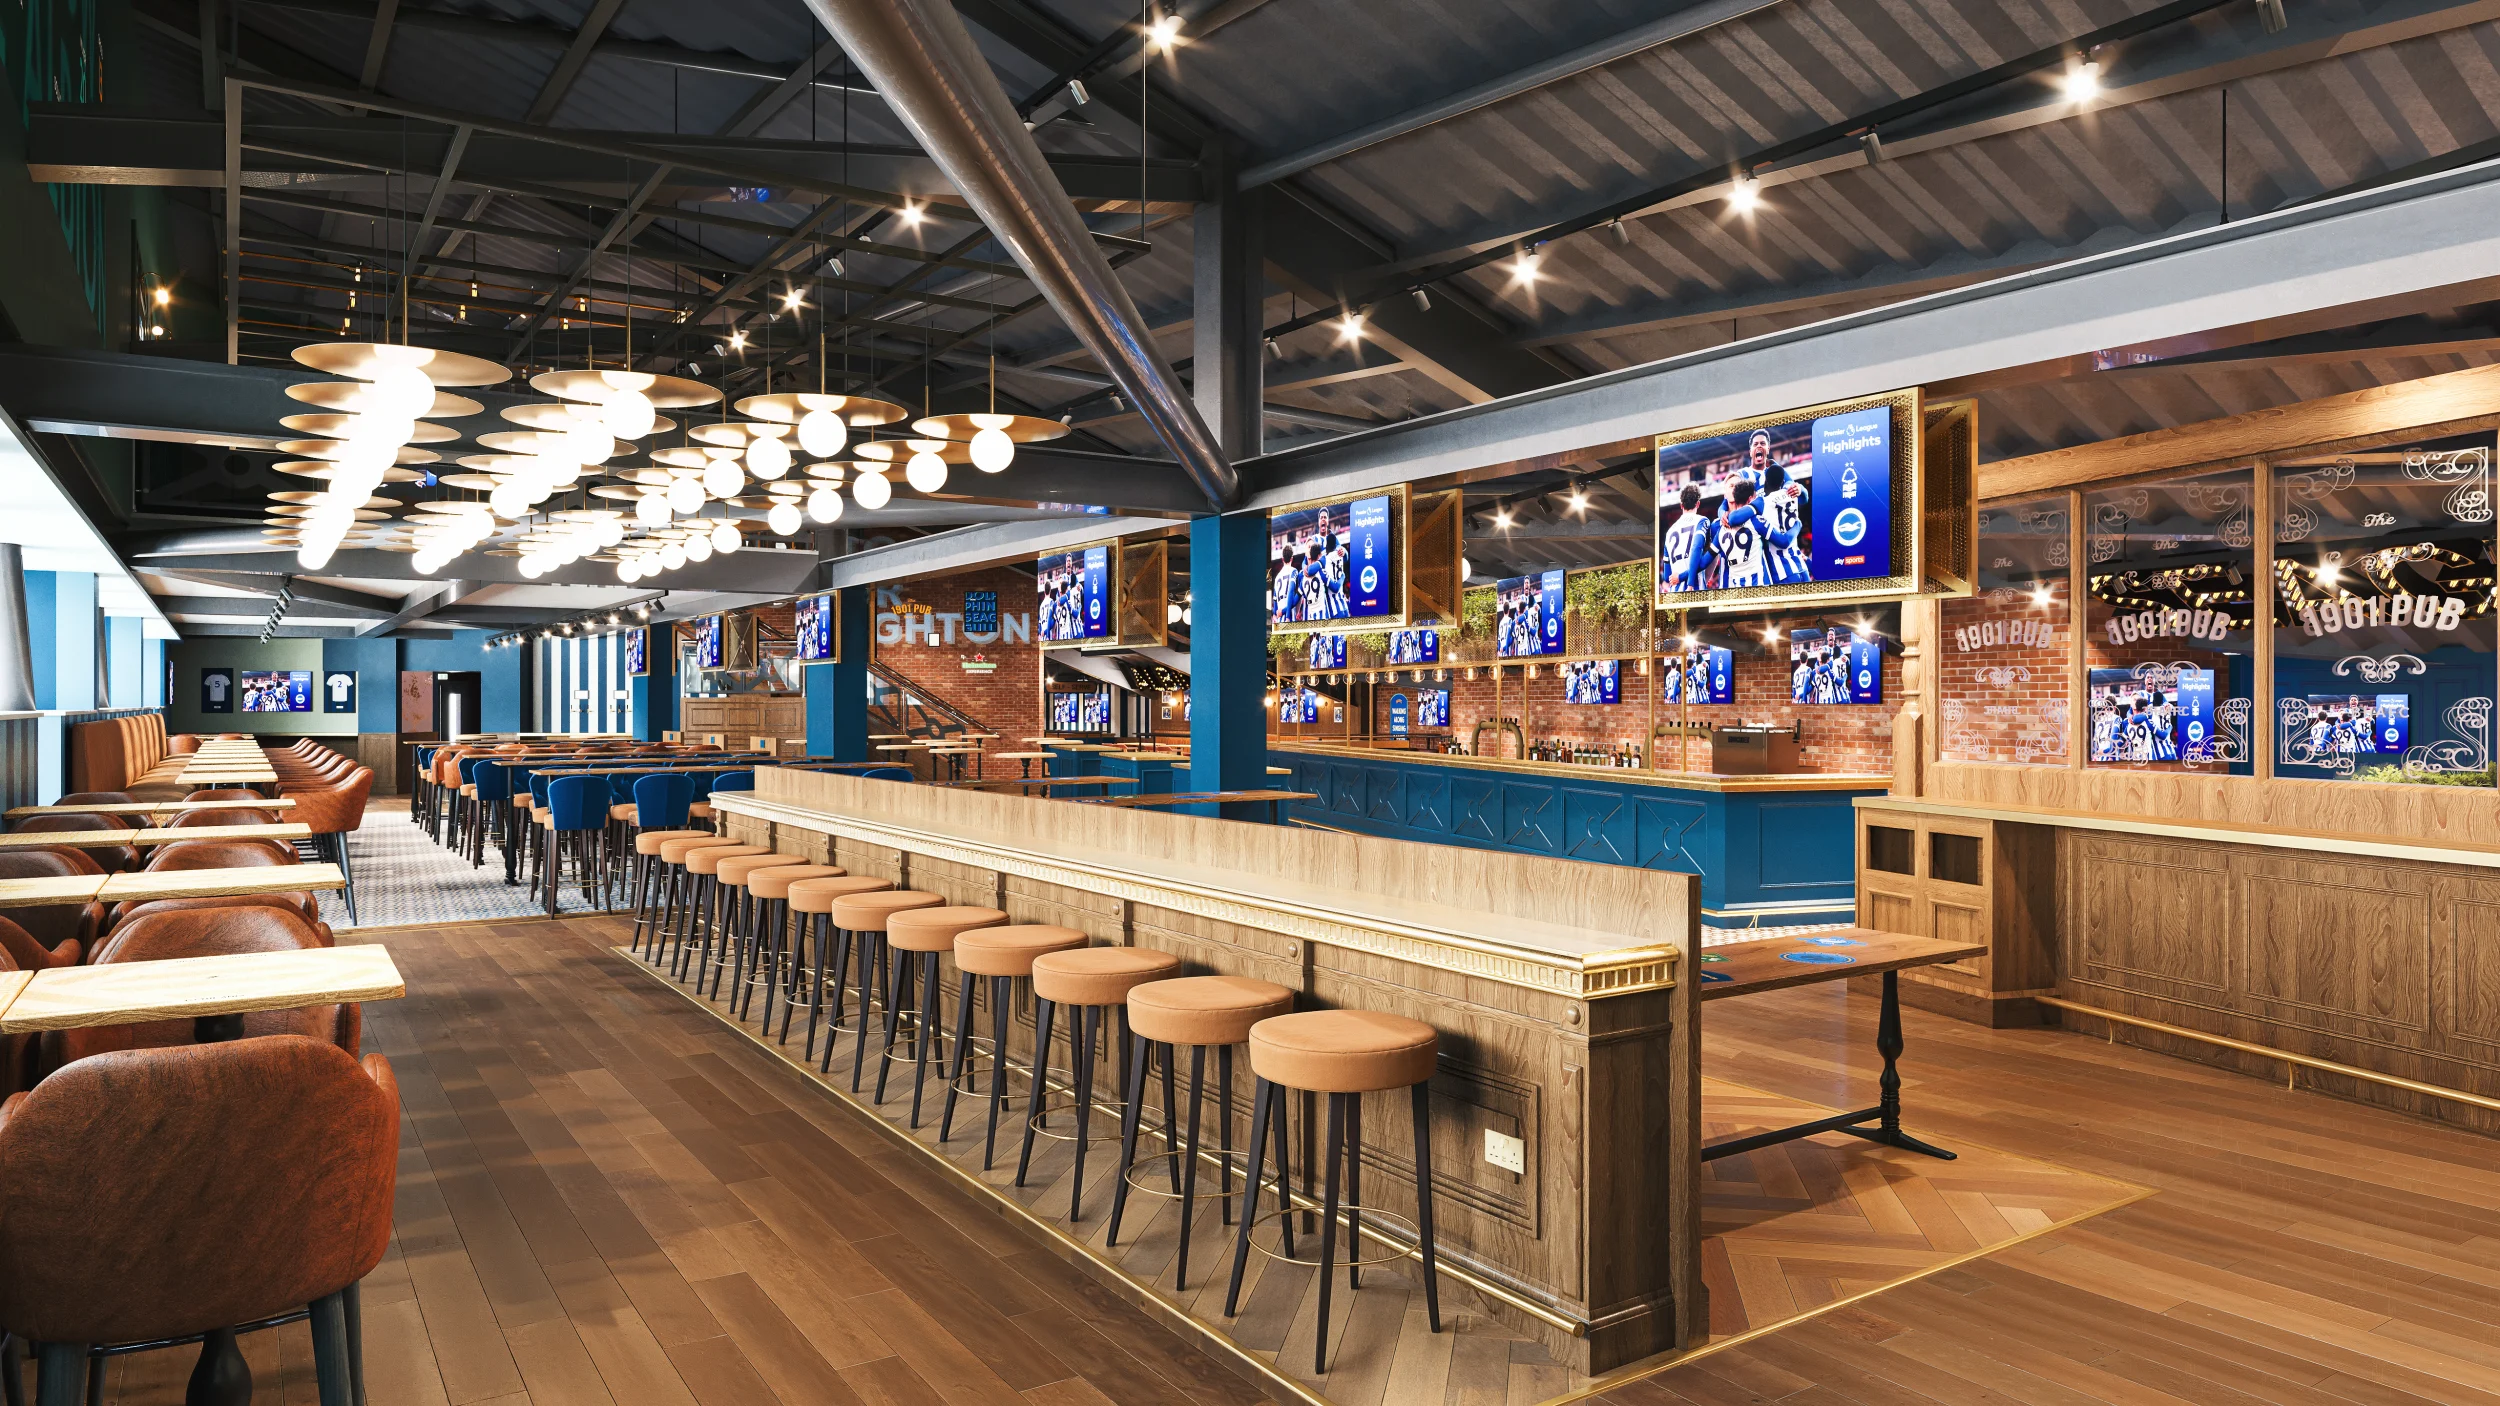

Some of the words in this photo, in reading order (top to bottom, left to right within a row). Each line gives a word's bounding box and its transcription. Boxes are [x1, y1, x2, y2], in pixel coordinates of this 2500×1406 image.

[1823, 428, 1845, 438] Premier
[1855, 423, 1879, 433] League
[1821, 435, 1882, 455] Highlights
[1354, 515, 1385, 528] Highlights
[2362, 512, 2397, 528] The
[1668, 525, 1695, 564] 27
[1721, 527, 1753, 566] 29
[2152, 539, 2180, 551] The
[1834, 557, 1845, 566] sky
[1845, 556, 1865, 565] sports
[1276, 575, 1290, 602] 27
[1303, 576, 1320, 604] 29
[891, 604, 911, 615] 1901
[914, 604, 932, 615] PUB
[2301, 595, 2378, 637] 1901
[2391, 594, 2466, 632] PUB
[2175, 608, 2231, 641] PUB
[2009, 619, 2054, 649] PUB
[214, 680, 221, 688] 5
[337, 680, 343, 688] 2
[2182, 683, 2211, 691] Highlights
[2128, 725, 2147, 746] 29
